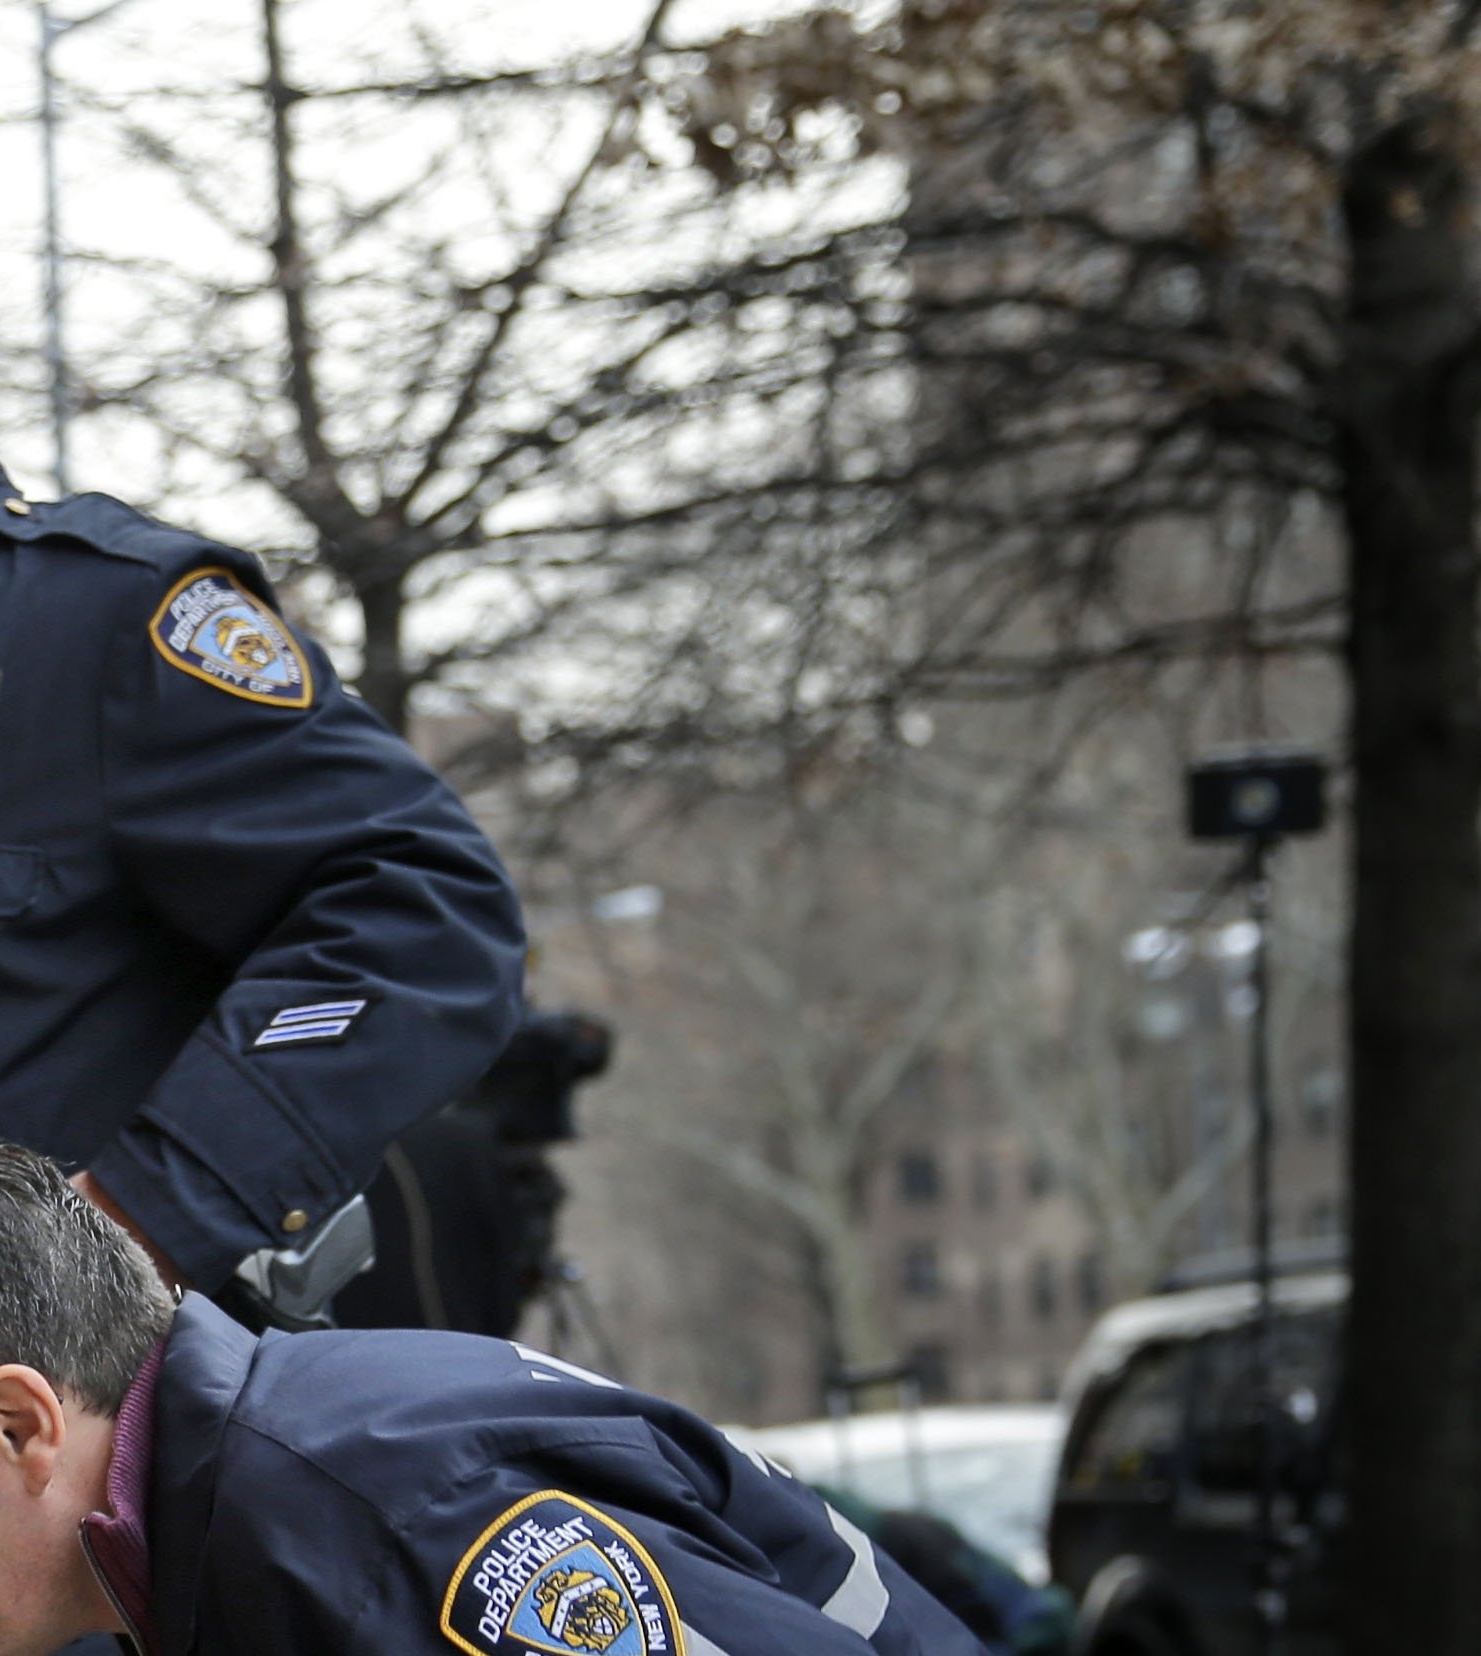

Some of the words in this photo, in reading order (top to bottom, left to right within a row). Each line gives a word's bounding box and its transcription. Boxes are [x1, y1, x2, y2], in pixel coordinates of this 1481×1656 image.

[170, 577, 219, 621] POLICE
[201, 659, 245, 686] CITY
[249, 679, 276, 694] OF
[473, 1518, 547, 1597] POLICE
[477, 1516, 595, 1645] DEPARTMENT
[603, 1540, 649, 1599] YORK
[638, 1603, 668, 1652] NEW
